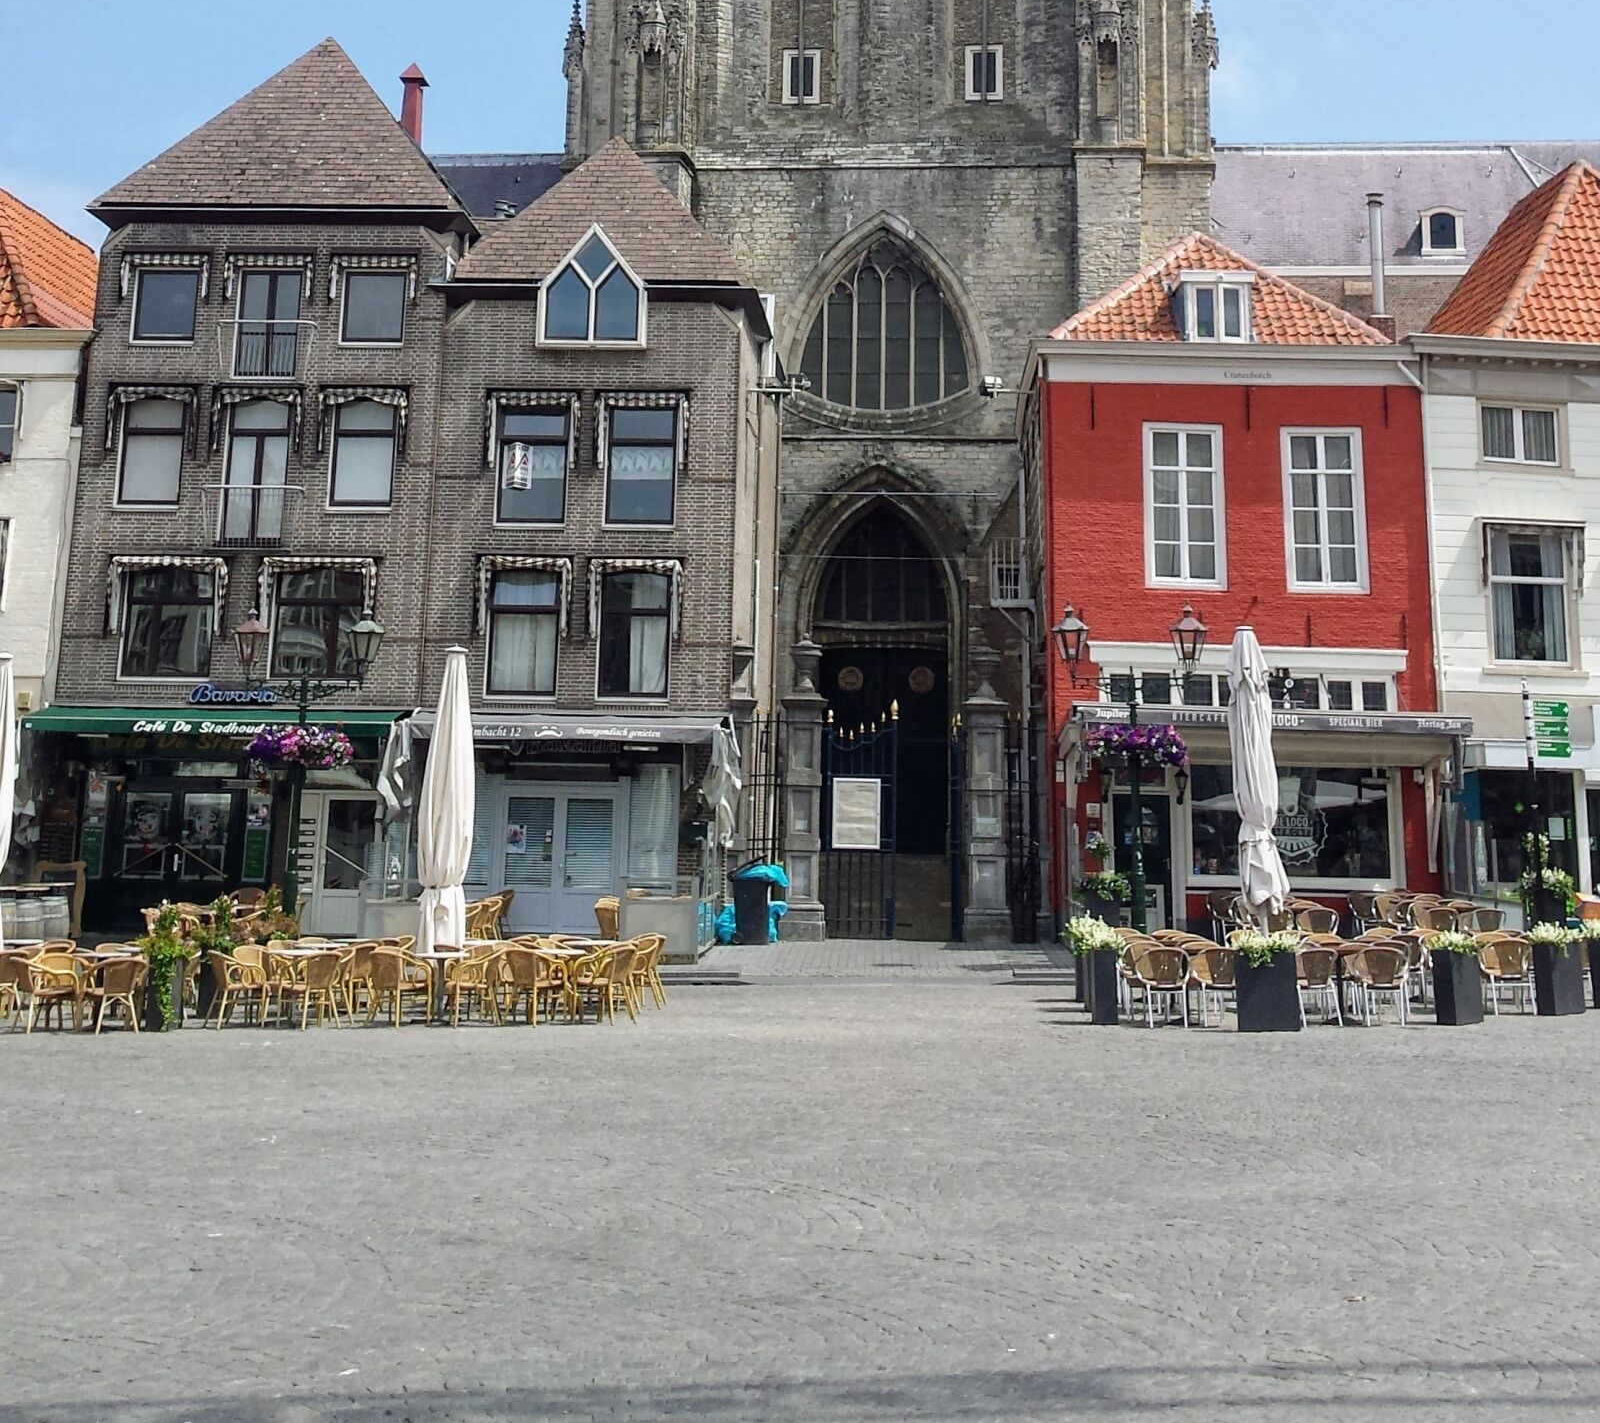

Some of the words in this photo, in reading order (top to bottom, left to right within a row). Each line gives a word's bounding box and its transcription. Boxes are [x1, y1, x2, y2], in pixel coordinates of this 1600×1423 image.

[189, 682, 278, 703] Bavaria
[1096, 708, 1130, 719] Jupiler
[133, 719, 167, 733] Café
[172, 720, 192, 733] De
[1272, 714, 1298, 727] LOCO
[1328, 717, 1364, 728] SPECIAAL
[1366, 718, 1383, 729] BIER
[473, 725, 507, 737] mbacht
[510, 727, 522, 737] 12
